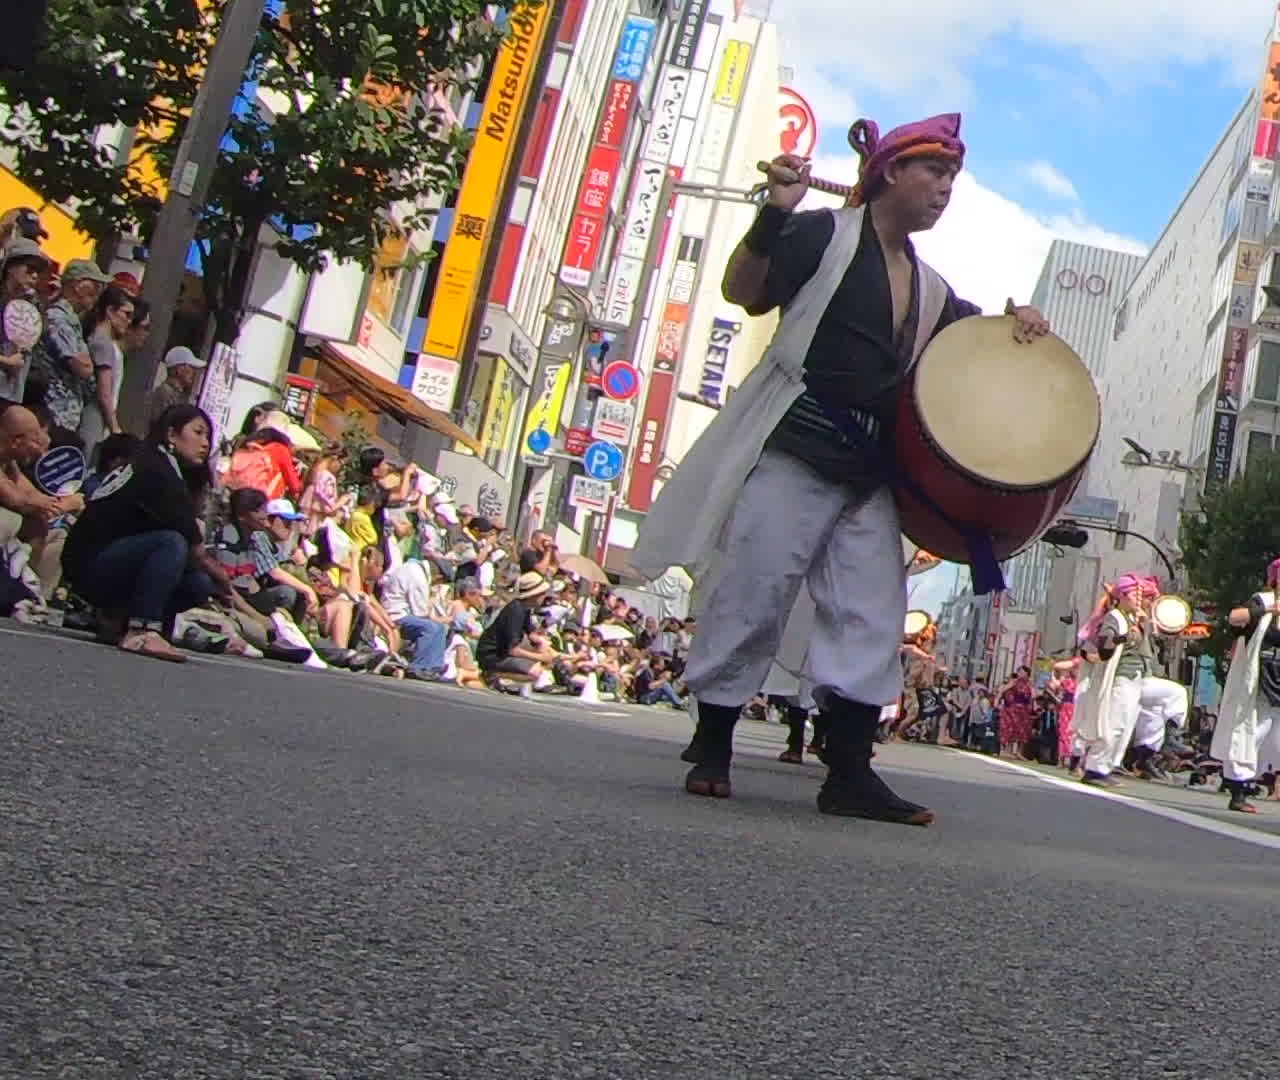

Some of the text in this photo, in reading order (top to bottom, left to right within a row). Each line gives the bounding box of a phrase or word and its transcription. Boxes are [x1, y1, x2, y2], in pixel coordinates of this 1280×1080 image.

[455, 213, 488, 241] 薬
[570, 168, 612, 270] 銀座カラー
[701, 316, 738, 403] ISETAN
[416, 382, 449, 400] サロン
